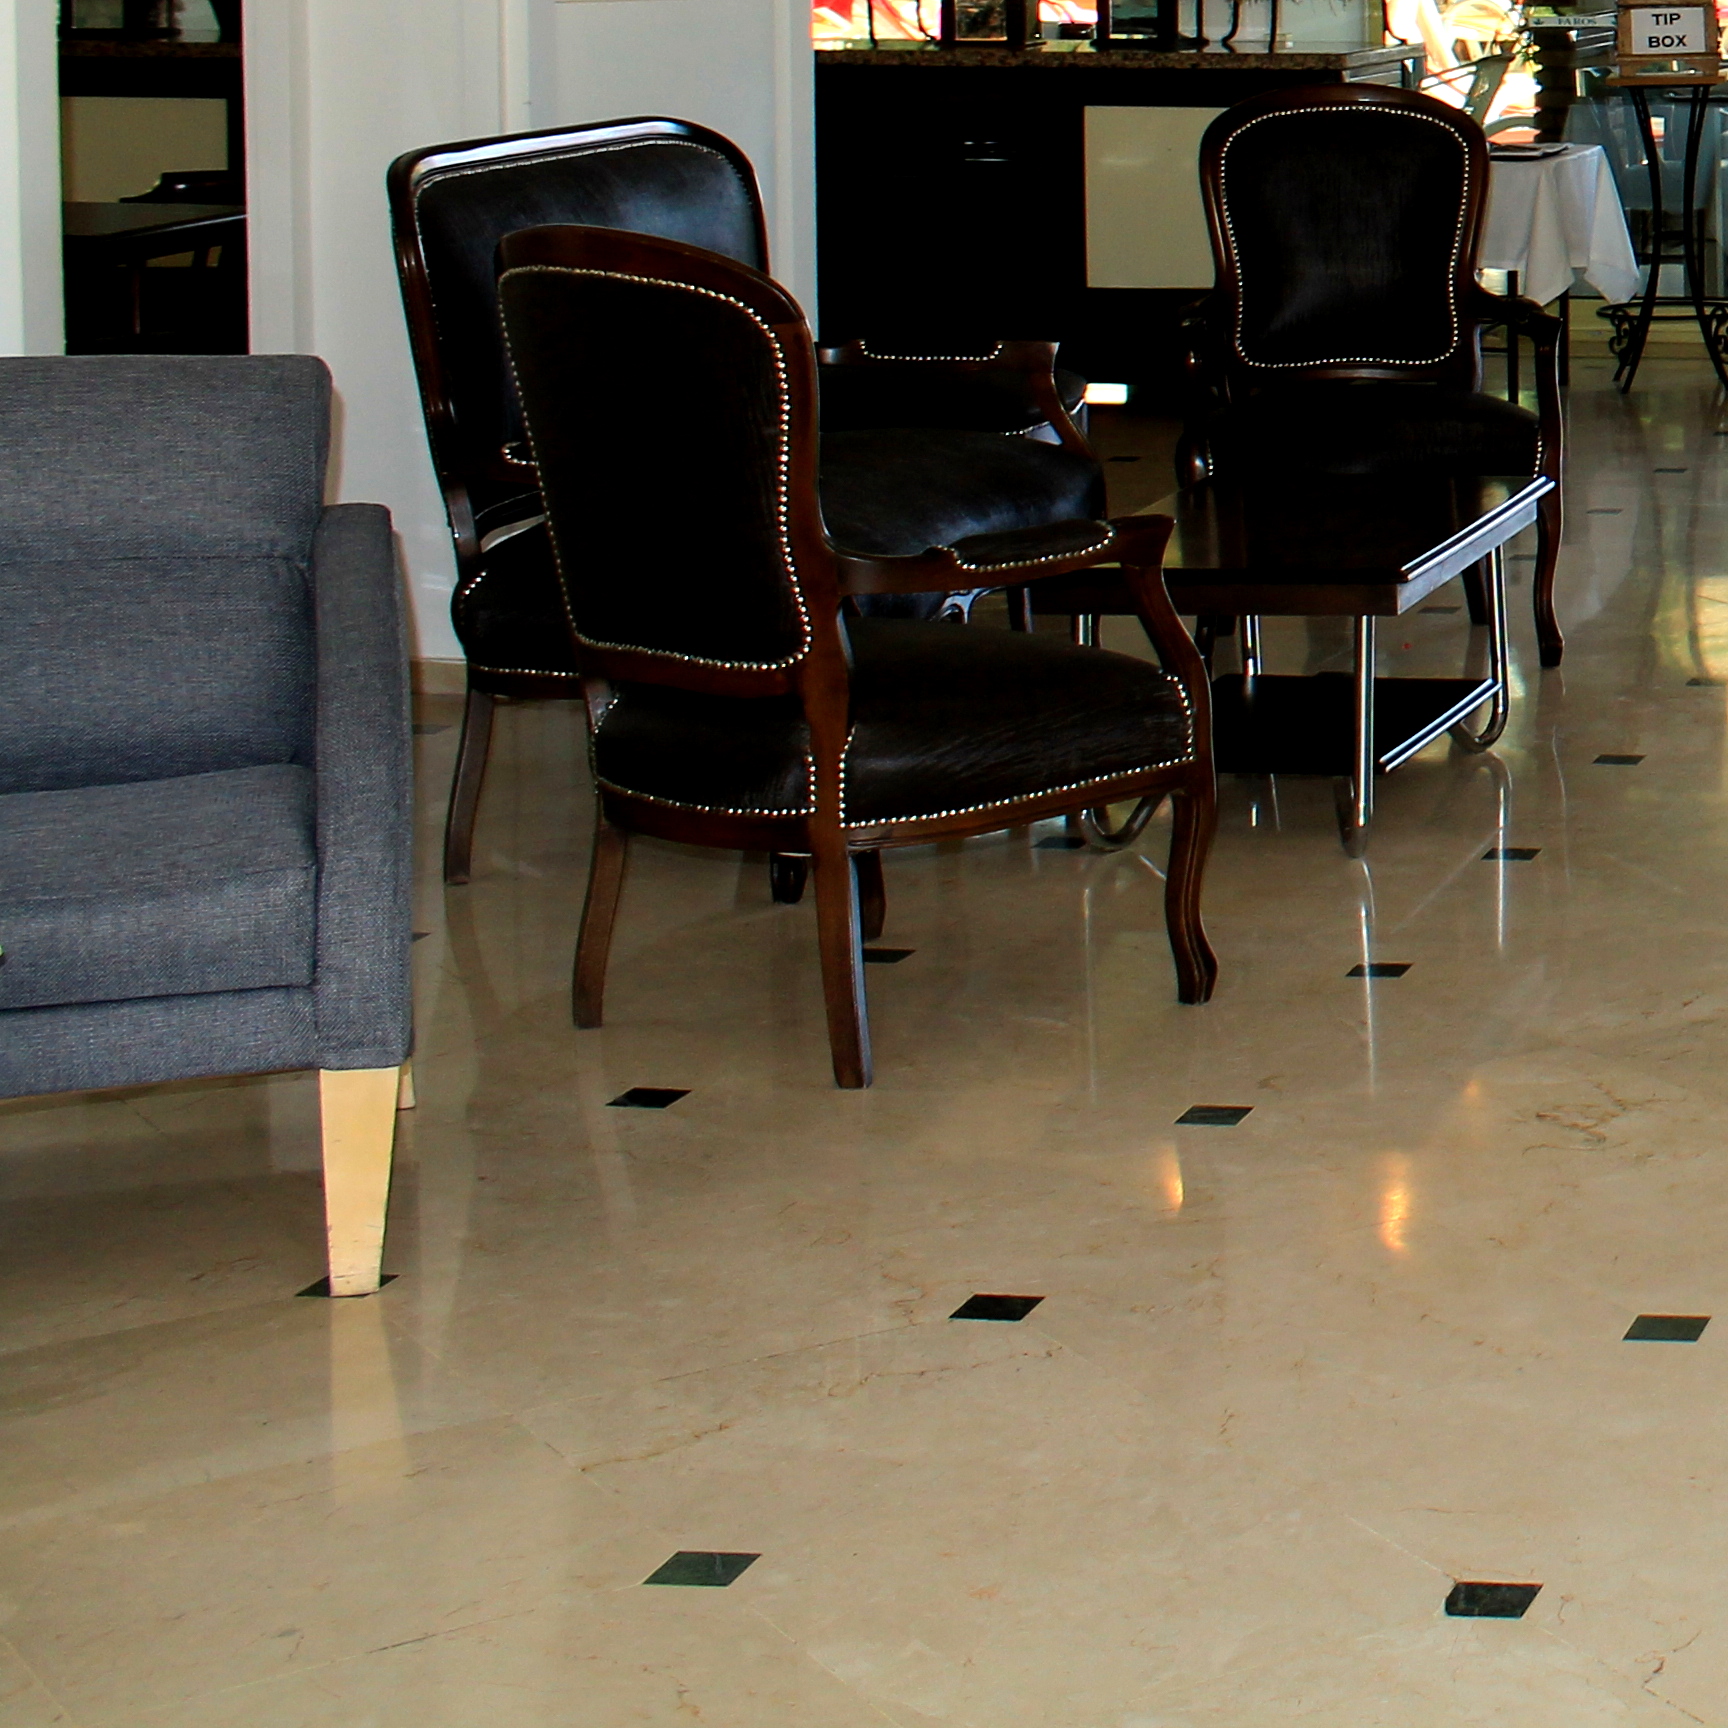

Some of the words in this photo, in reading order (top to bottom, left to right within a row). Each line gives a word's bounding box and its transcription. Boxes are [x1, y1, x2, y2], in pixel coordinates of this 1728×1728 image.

[1557, 17, 1597, 26] FAROS
[1652, 13, 1681, 26] TIP
[1648, 35, 1688, 49] BOX
